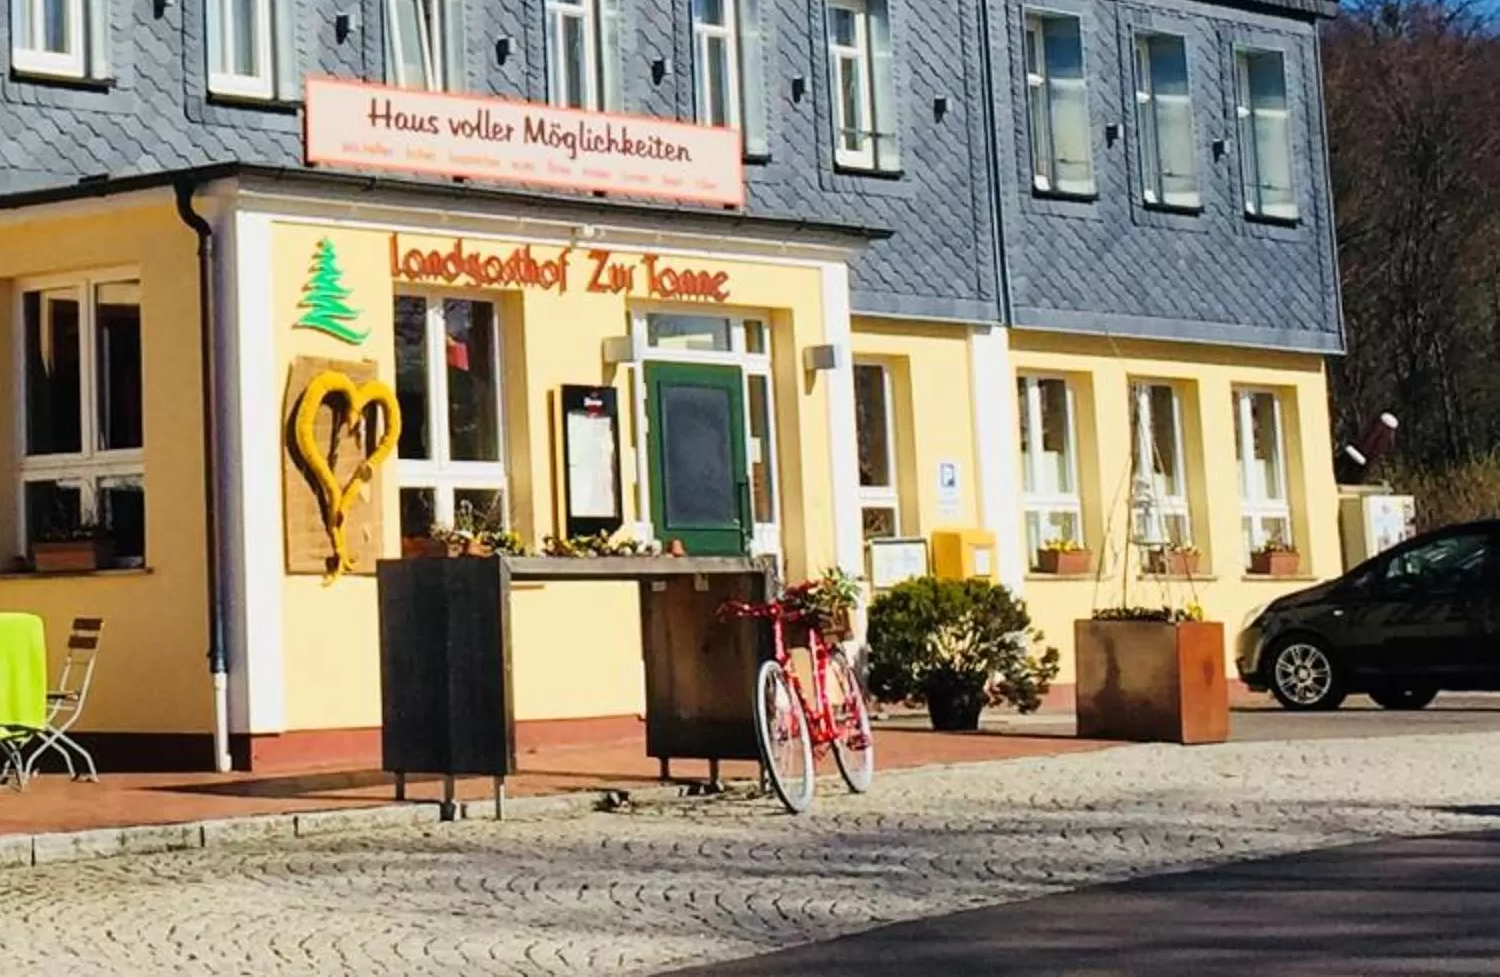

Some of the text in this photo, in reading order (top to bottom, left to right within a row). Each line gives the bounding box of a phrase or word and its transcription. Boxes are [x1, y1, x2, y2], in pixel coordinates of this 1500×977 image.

[366, 97, 439, 135] Haus
[448, 108, 515, 144] voller
[522, 115, 694, 162] Möglichkeiten
[388, 231, 732, 302] Landgasthof Zur Tanne
